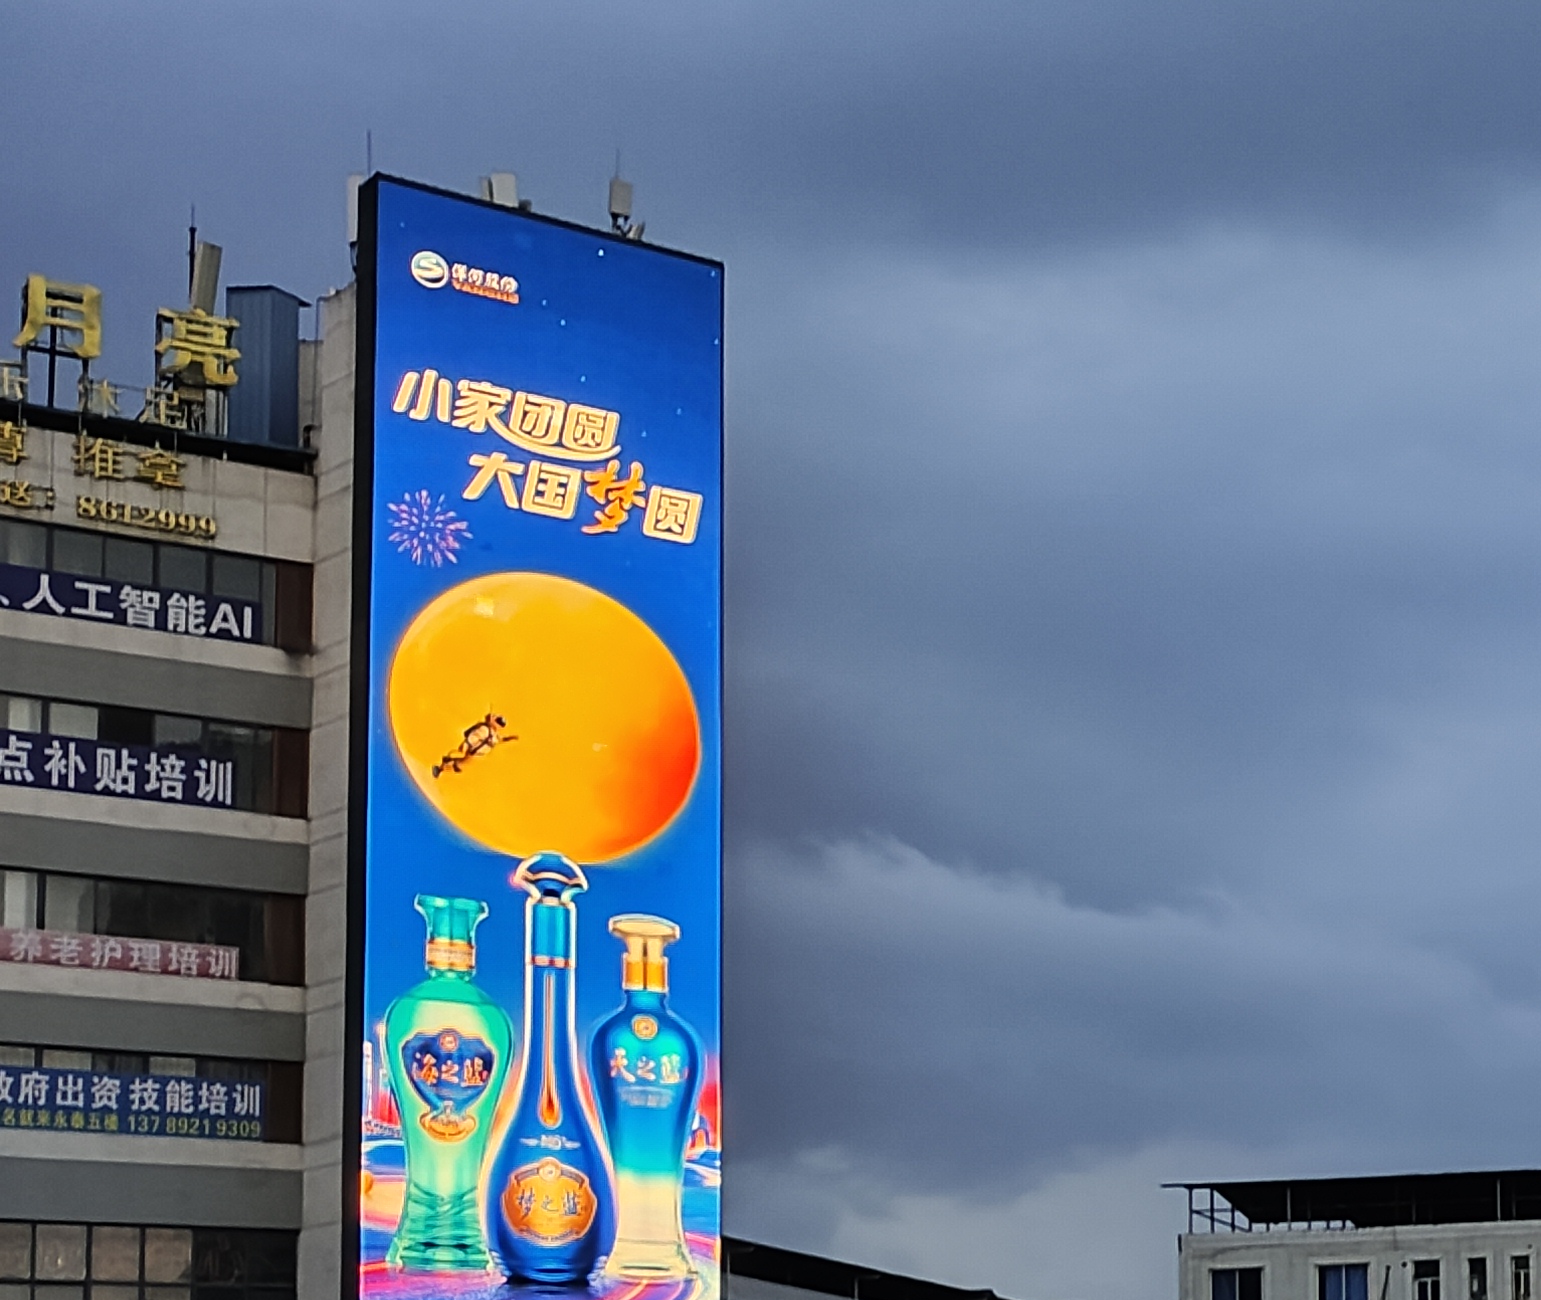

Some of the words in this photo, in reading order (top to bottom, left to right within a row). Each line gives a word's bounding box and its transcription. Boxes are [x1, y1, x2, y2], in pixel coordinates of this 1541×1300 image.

[392, 368, 622, 462] 小家团圆
[77, 494, 217, 540] 8612999
[462, 451, 704, 544] 大国梦圆
[0, 734, 234, 806] 点补贴培训
[10, 931, 239, 980] 养老护理培训
[128, 1114, 160, 1133] 137
